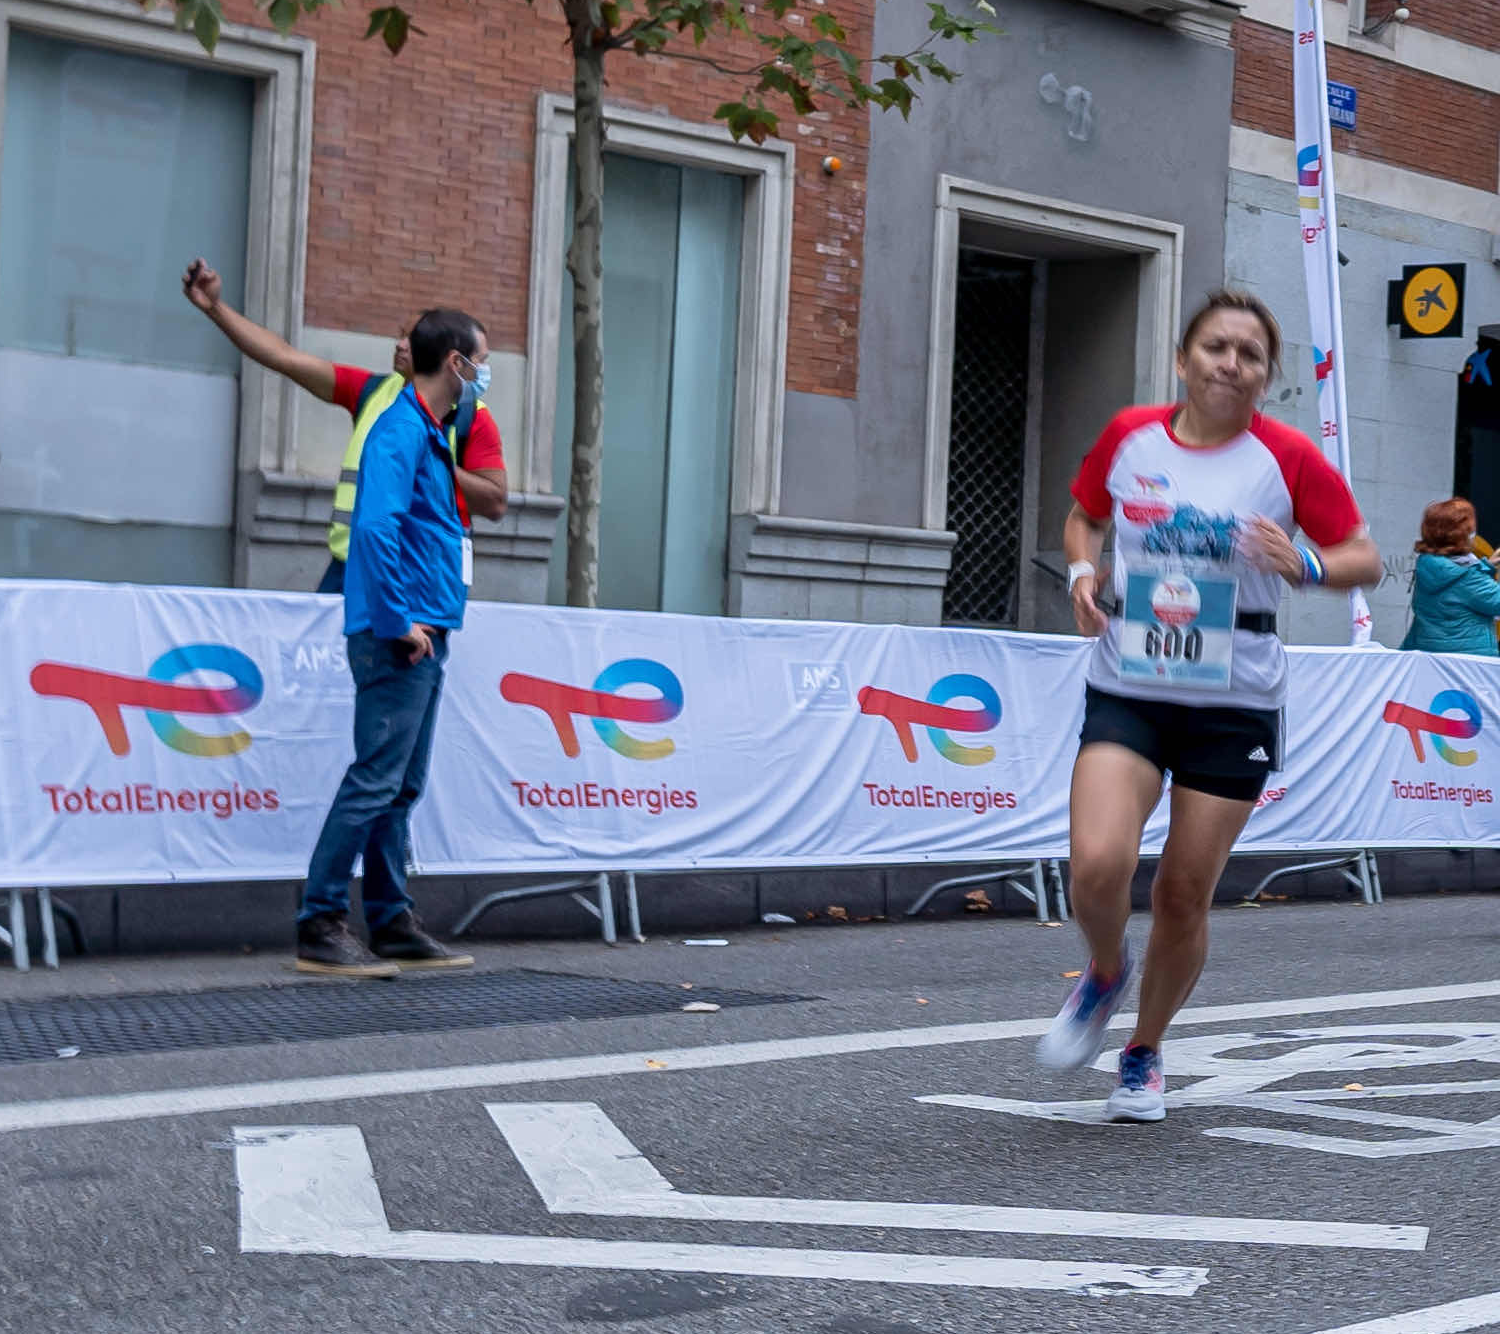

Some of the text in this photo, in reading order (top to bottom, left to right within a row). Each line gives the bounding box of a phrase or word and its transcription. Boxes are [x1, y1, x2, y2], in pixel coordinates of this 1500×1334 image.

[1145, 624, 1204, 662] 600
[41, 782, 280, 820] TotalEnergies
[511, 780, 698, 815] TotalEnergies
[863, 782, 1017, 815] TotalEnergies
[1391, 780, 1493, 807] TotalEnergies
